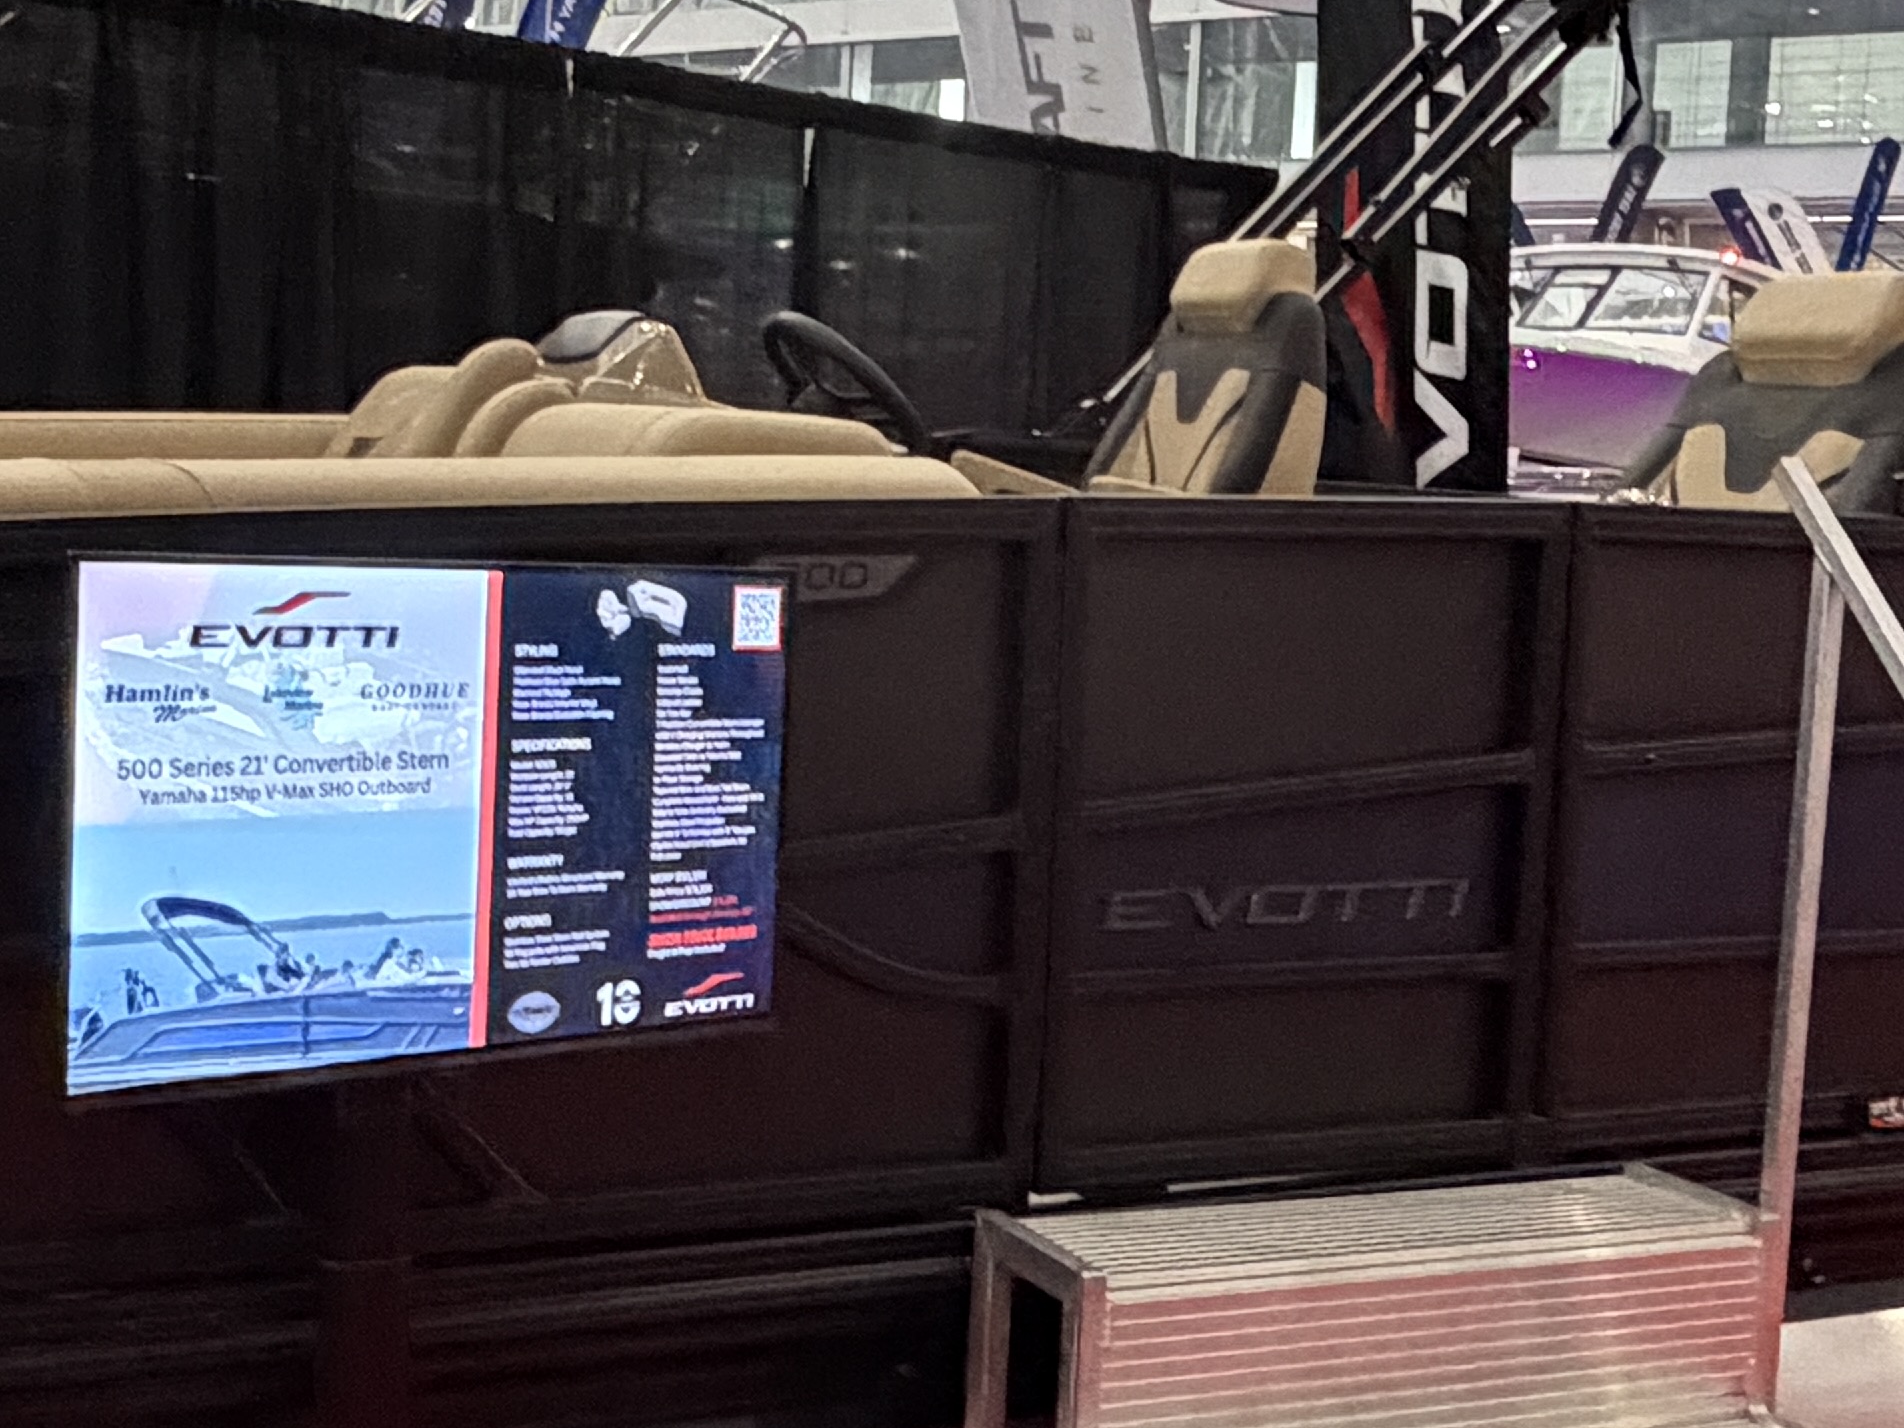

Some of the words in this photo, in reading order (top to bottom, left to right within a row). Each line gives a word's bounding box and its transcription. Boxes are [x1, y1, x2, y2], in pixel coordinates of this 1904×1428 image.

[189, 625, 399, 648] EVOTTI
[105, 682, 210, 703] Hamlin's
[117, 758, 162, 781] 500
[169, 756, 235, 779] Series
[240, 754, 269, 776] 21'
[273, 751, 392, 775] Convertible
[396, 750, 450, 771] Stern
[139, 787, 208, 806] Yamaha
[211, 784, 262, 803] 115hp
[264, 783, 316, 801] V-Max
[319, 780, 354, 799] SHO
[357, 777, 432, 796] Outboard
[1099, 878, 1471, 931] EVOTTI
[663, 993, 755, 1017] EVOTTI
